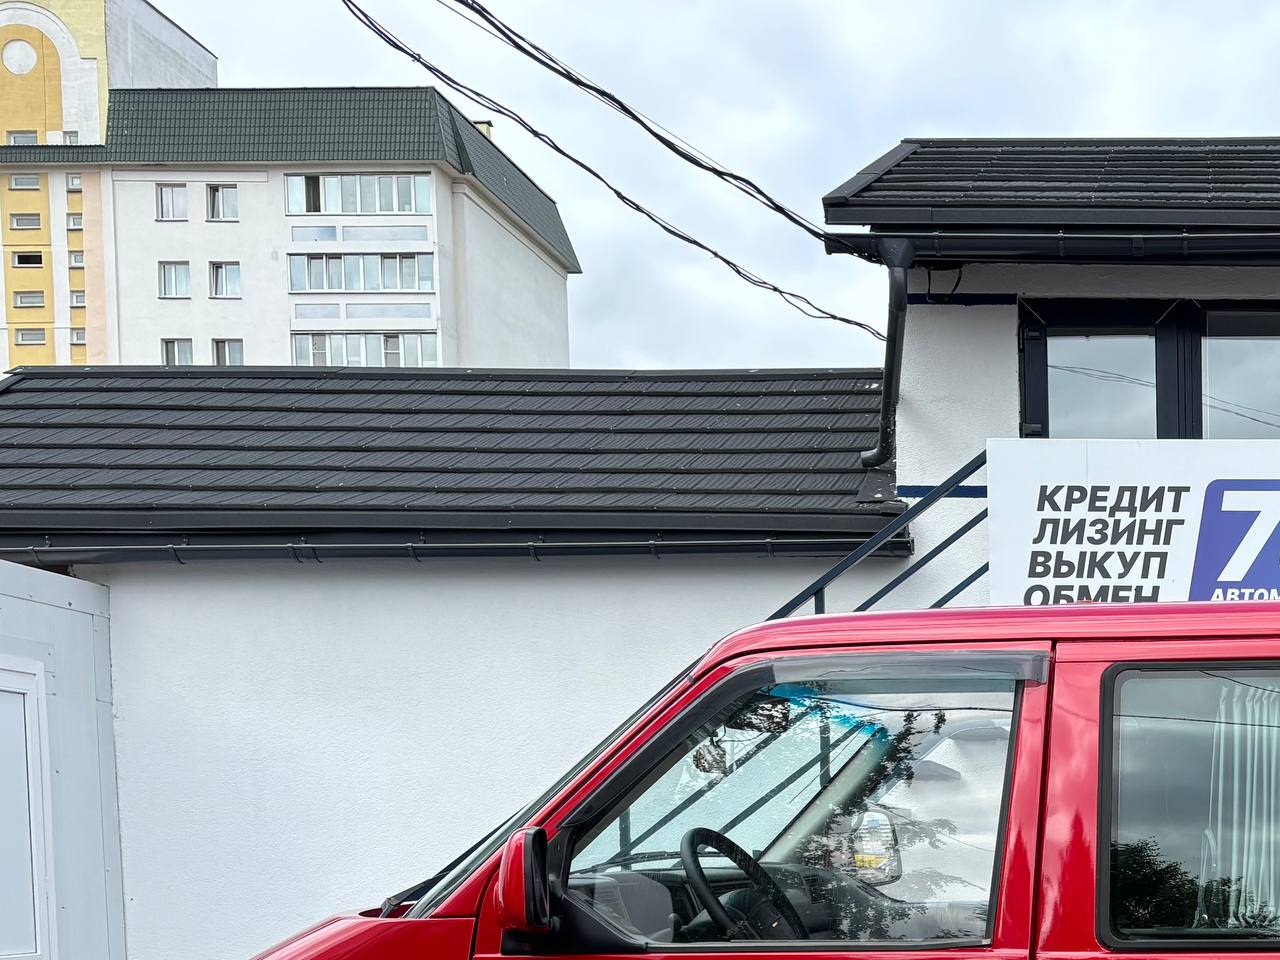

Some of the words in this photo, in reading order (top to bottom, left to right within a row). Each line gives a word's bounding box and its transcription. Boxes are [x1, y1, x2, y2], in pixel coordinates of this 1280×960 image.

[1037, 485, 1191, 518] КРЕДИТ
[1032, 518, 1185, 546] ЛИЗИНГ
[1028, 550, 1169, 580] ВЫКУП
[1023, 584, 1161, 607] ОБМЕН
